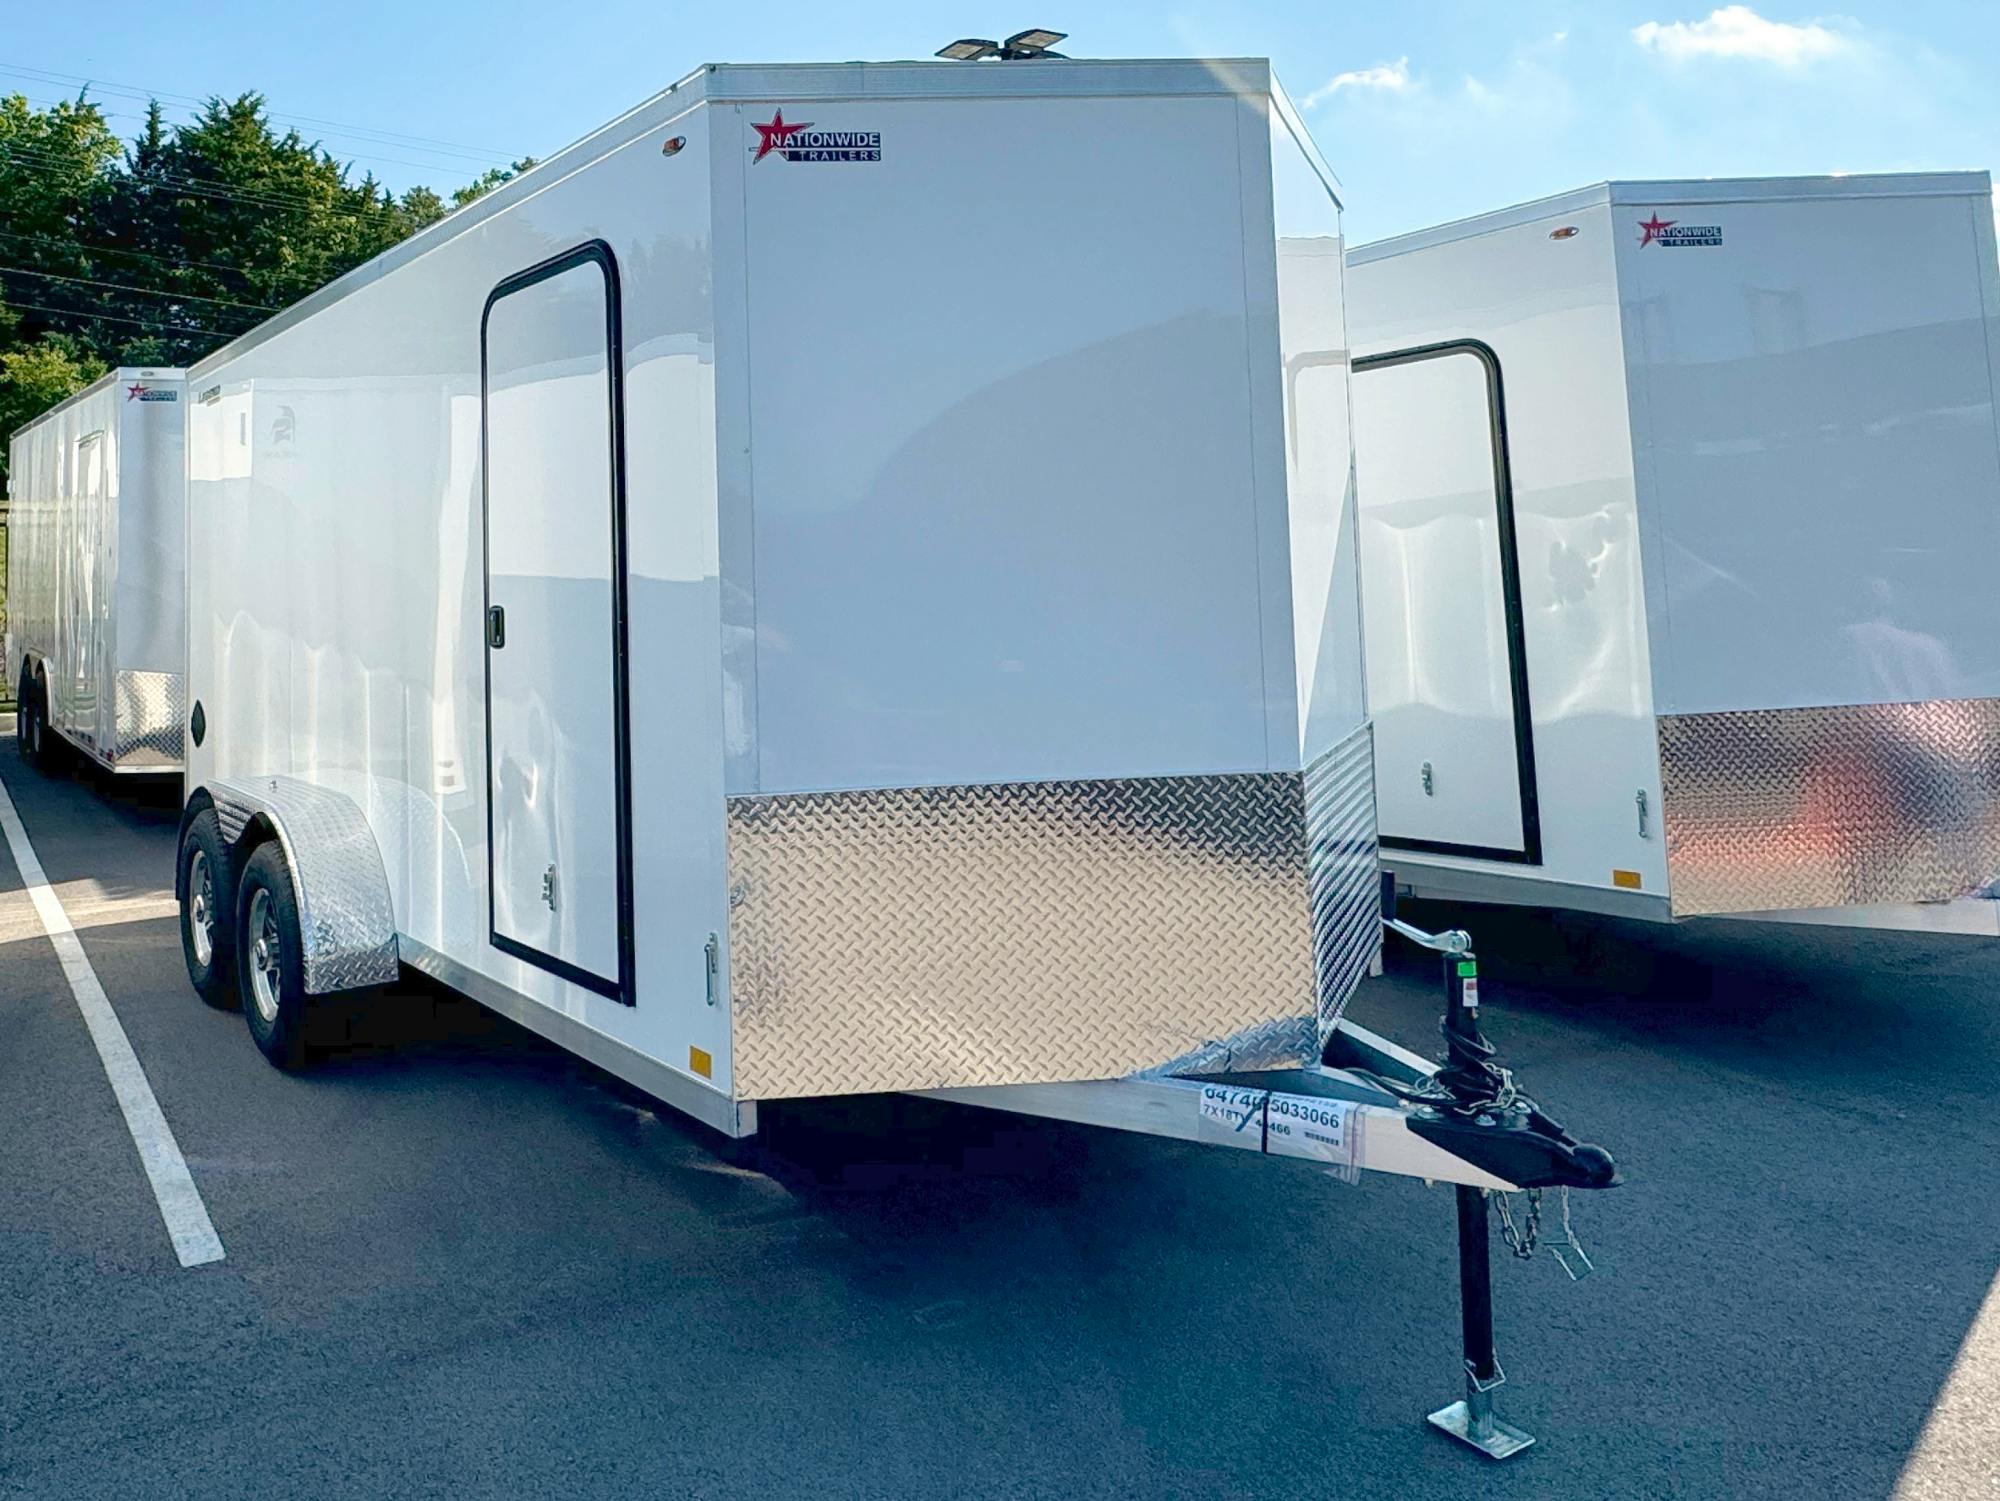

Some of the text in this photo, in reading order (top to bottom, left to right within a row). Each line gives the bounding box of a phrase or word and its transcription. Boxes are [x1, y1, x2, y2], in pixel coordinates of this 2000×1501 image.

[770, 132, 880, 147] NATIONWIDE
[799, 151, 880, 161] TRAILERS
[1650, 226, 1721, 237] NATIONWIDE
